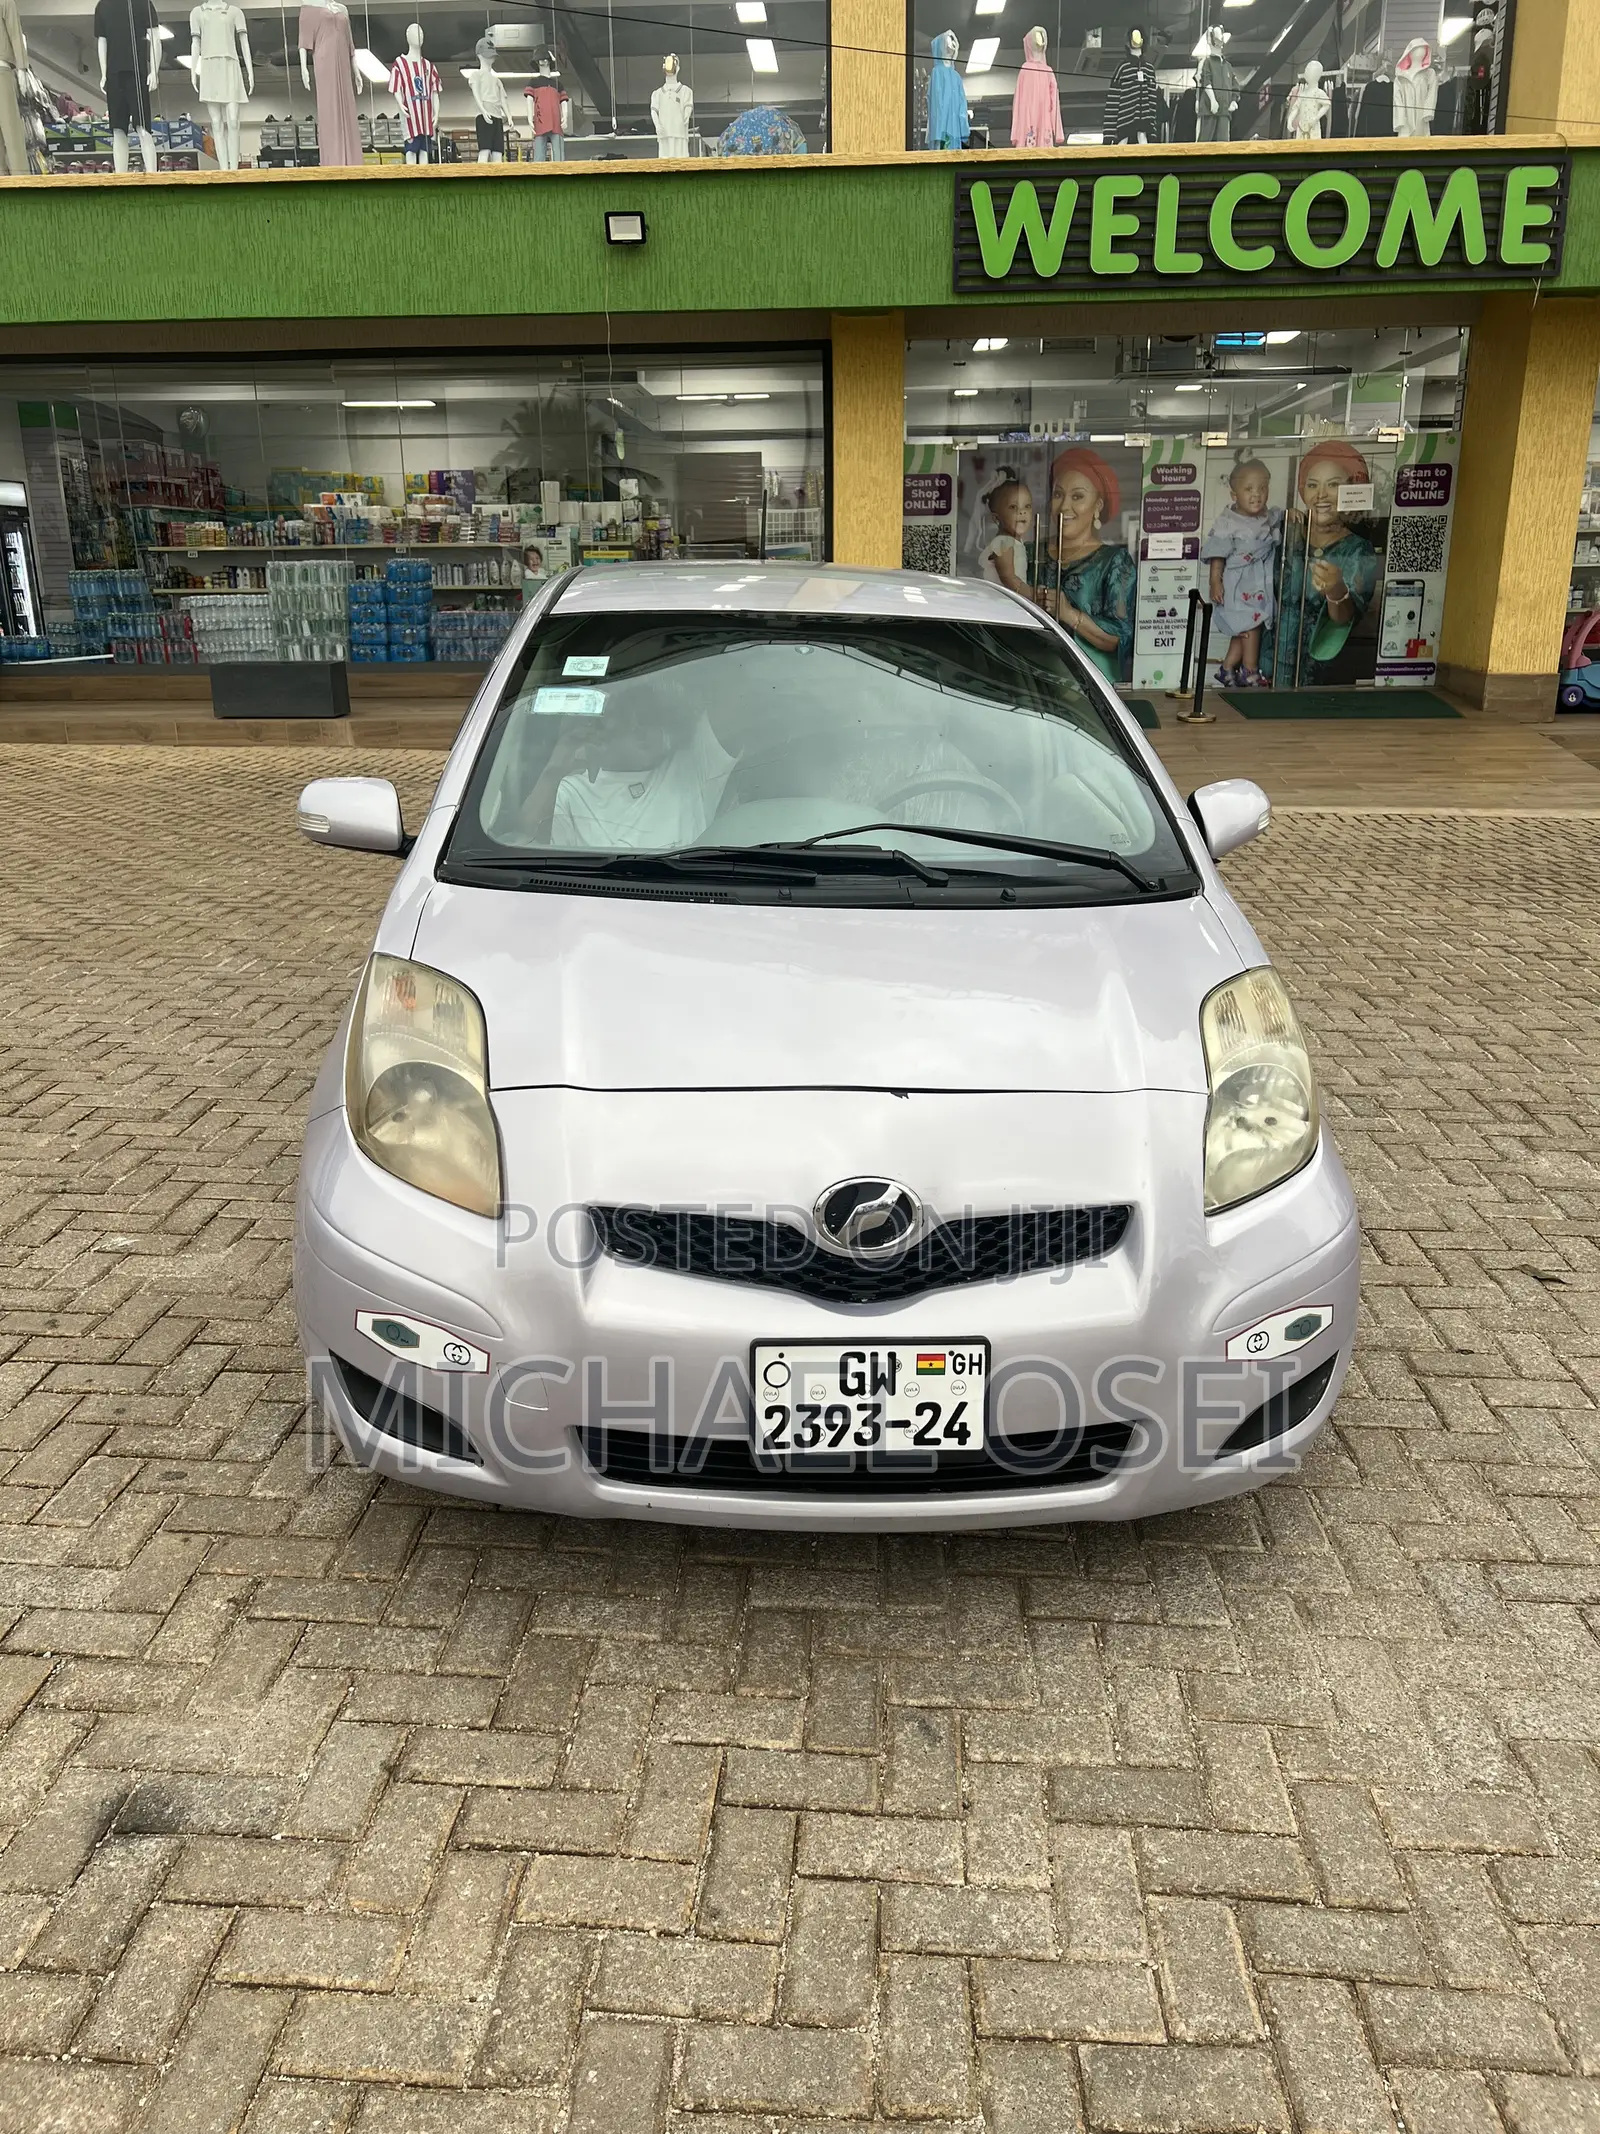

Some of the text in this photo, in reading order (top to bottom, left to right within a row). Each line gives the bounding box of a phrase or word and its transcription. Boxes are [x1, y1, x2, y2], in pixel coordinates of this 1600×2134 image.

[969, 165, 1560, 279] WELCOME
[1029, 418, 1080, 438] OUT
[1156, 465, 1193, 475] Working
[1403, 468, 1447, 477] Scan to
[904, 478, 947, 487] Scan to
[1408, 479, 1439, 490] Shop
[911, 489, 940, 500] Shop
[1400, 490, 1445, 500] ONLINE
[904, 500, 947, 509] ONLINE
[1154, 637, 1176, 647] EXIT
[952, 1353, 983, 1375] GH
[839, 1351, 897, 1396] GW
[763, 1401, 971, 1450] 2393-24
